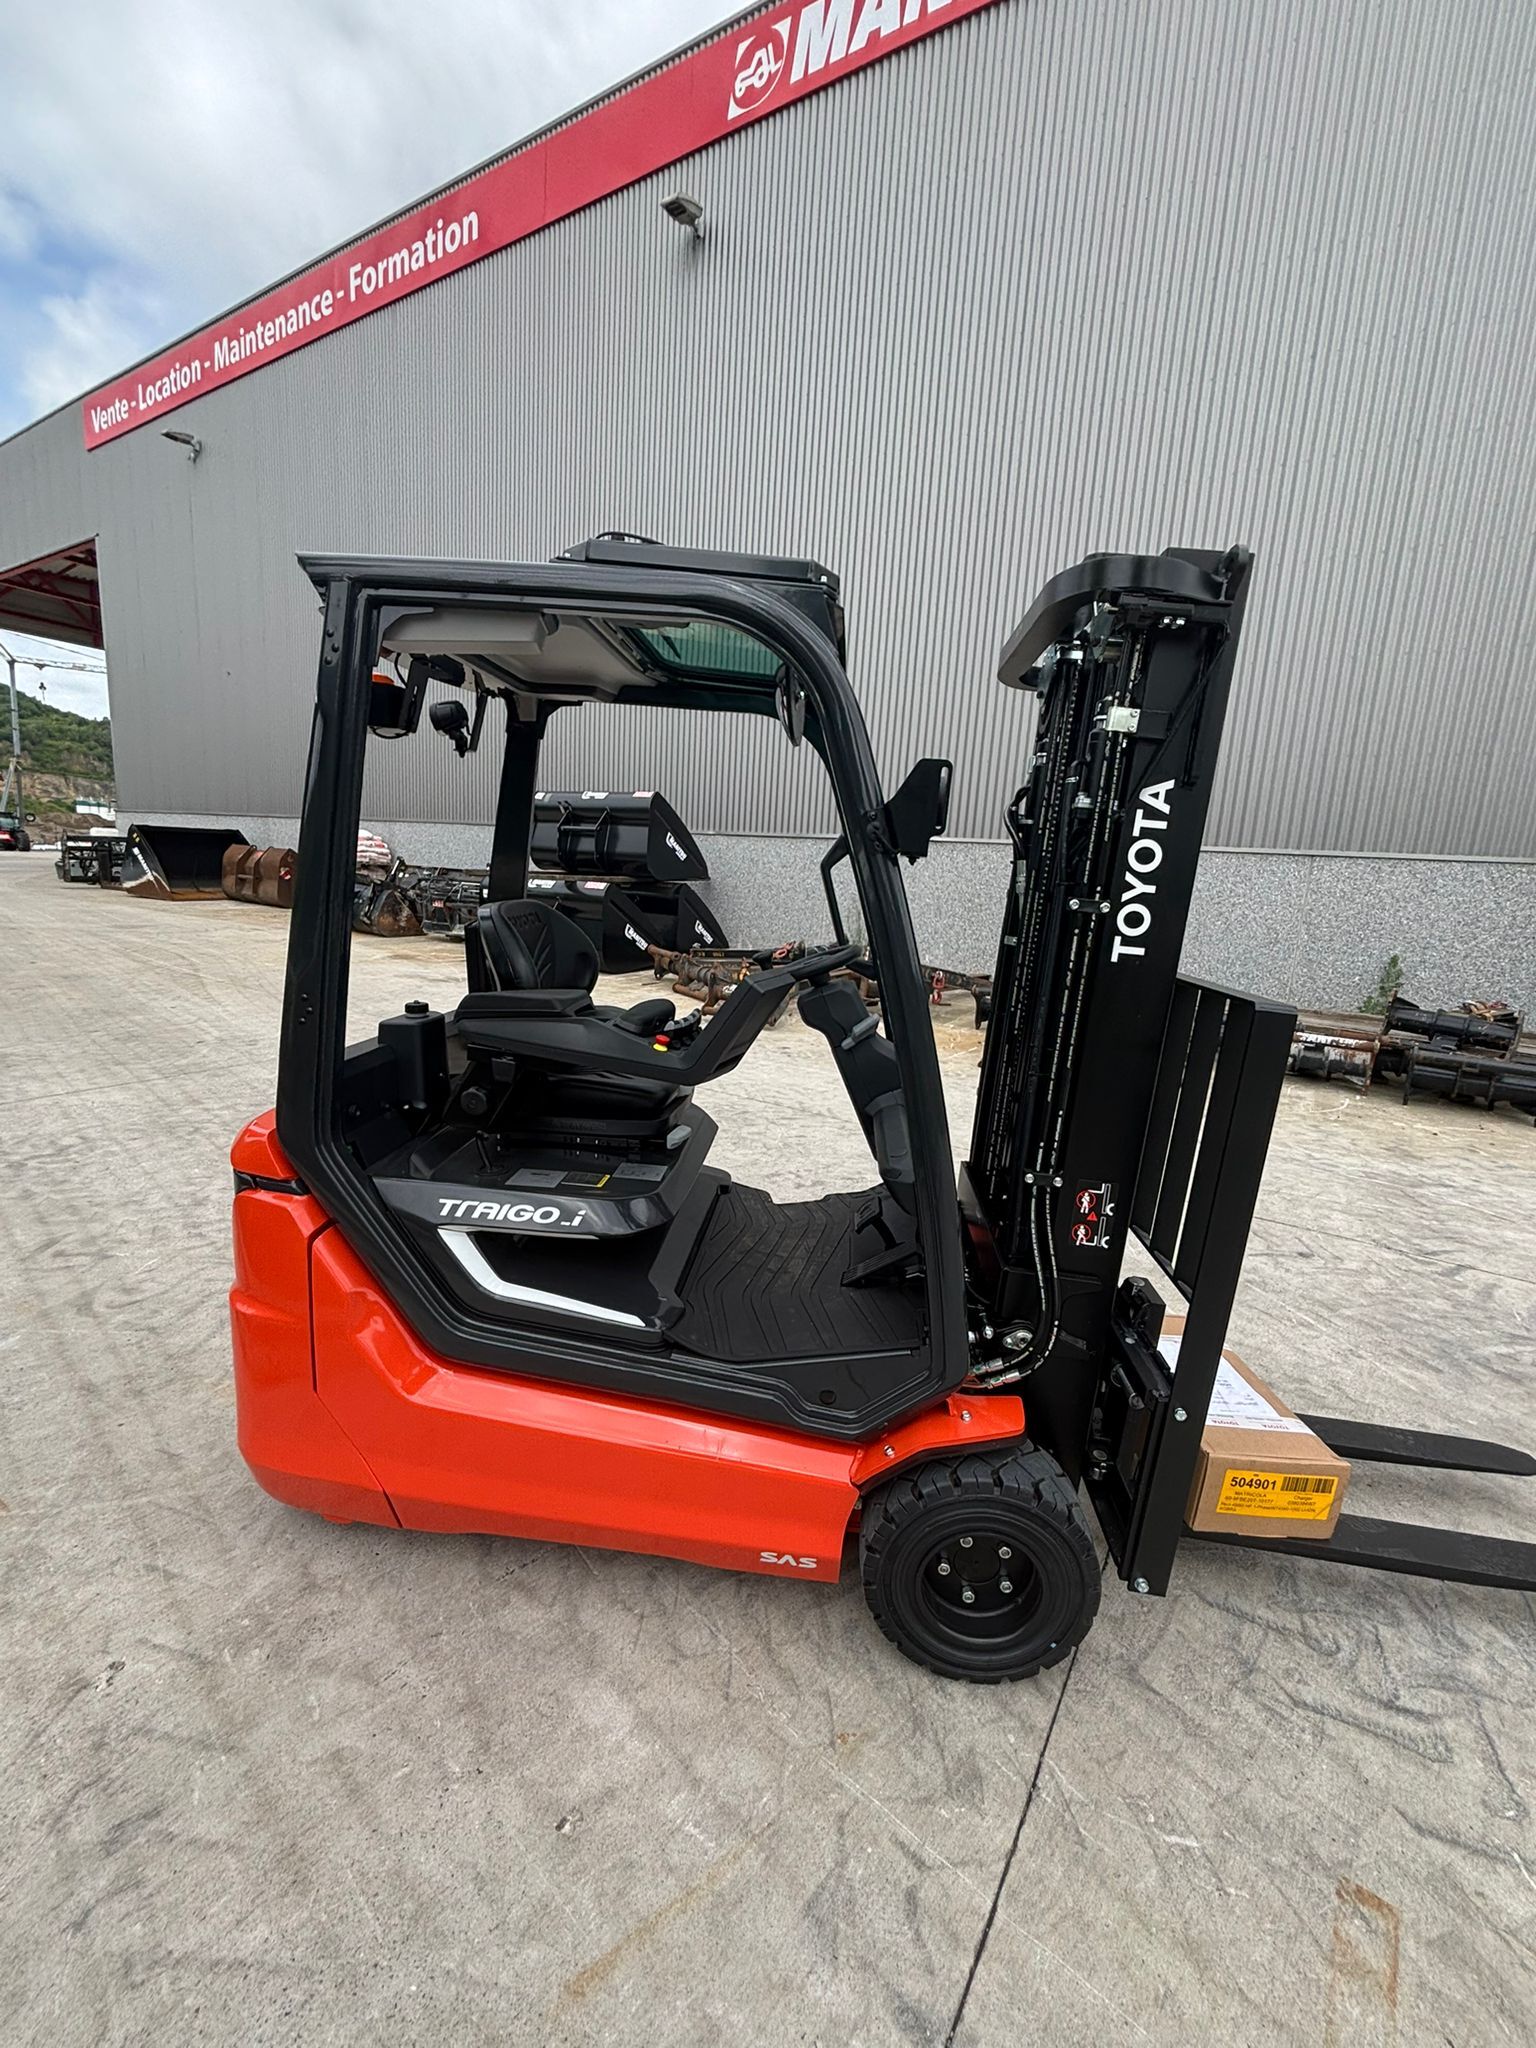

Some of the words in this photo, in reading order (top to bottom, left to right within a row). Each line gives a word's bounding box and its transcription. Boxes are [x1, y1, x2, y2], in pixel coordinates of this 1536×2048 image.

[91, 402, 128, 433] Vente
[138, 358, 201, 410] Location
[214, 290, 332, 372] Maintenance
[350, 211, 478, 302] Formation
[1110, 779, 1175, 963] TOYOTA
[1230, 1476, 1277, 1491] 504901
[760, 1551, 817, 1568] SAS
